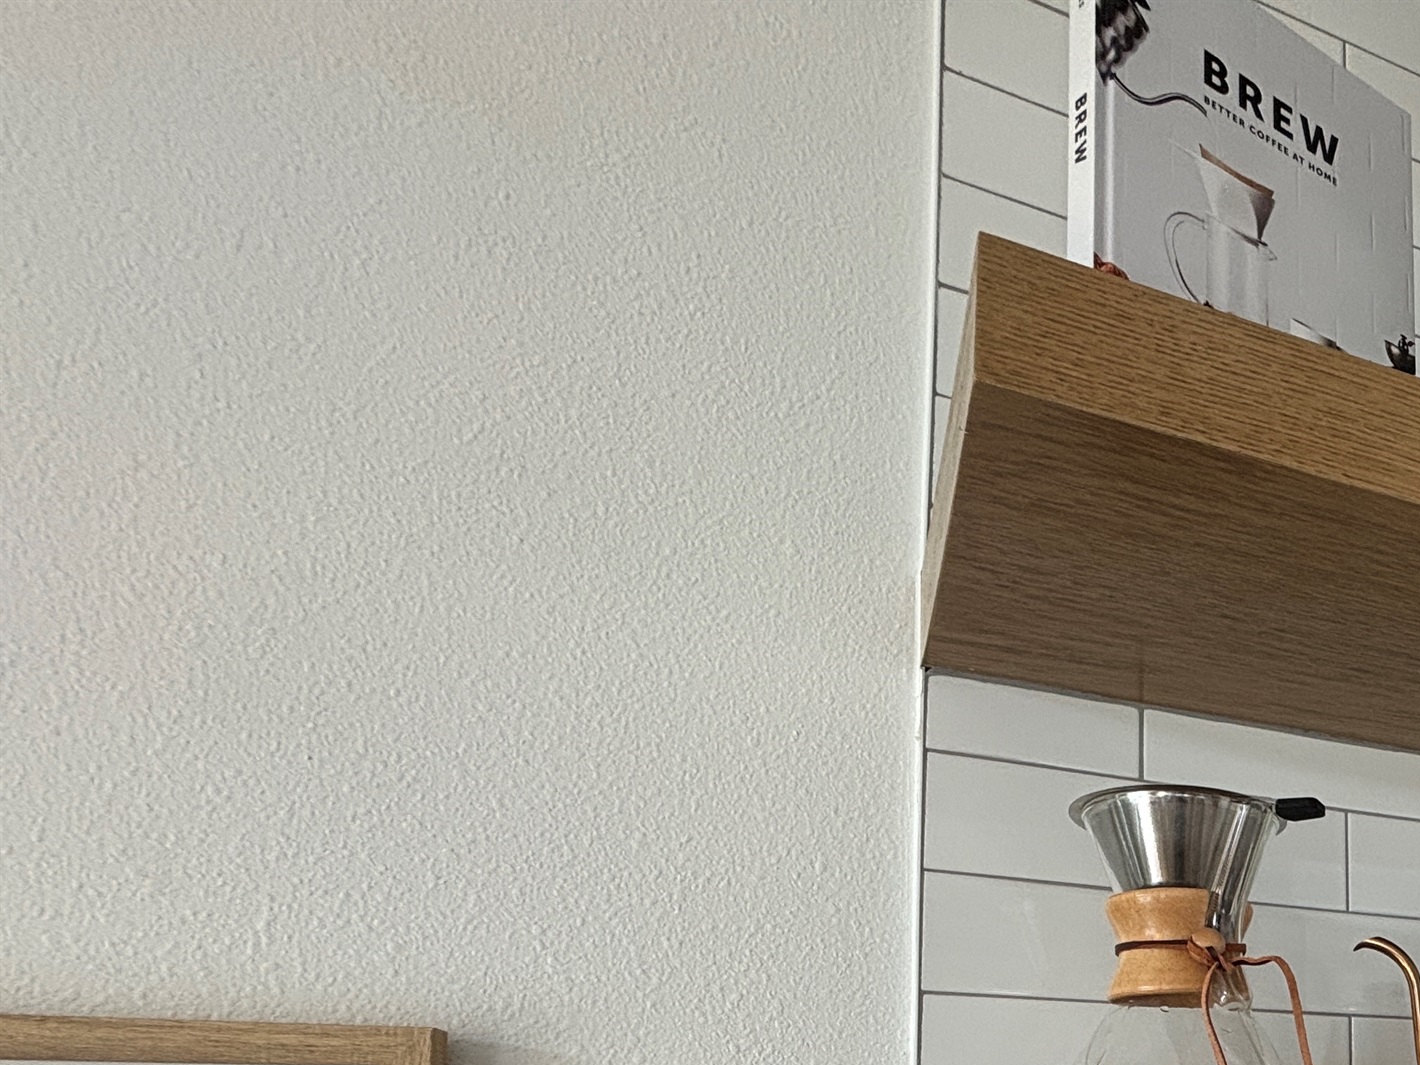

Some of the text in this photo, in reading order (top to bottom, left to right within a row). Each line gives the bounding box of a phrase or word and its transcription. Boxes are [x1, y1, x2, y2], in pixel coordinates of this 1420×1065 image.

[1074, 92, 1088, 164] BREW
[1203, 48, 1340, 167] BREW
[1203, 95, 1337, 187] BETTER COFFEE AT HOME
